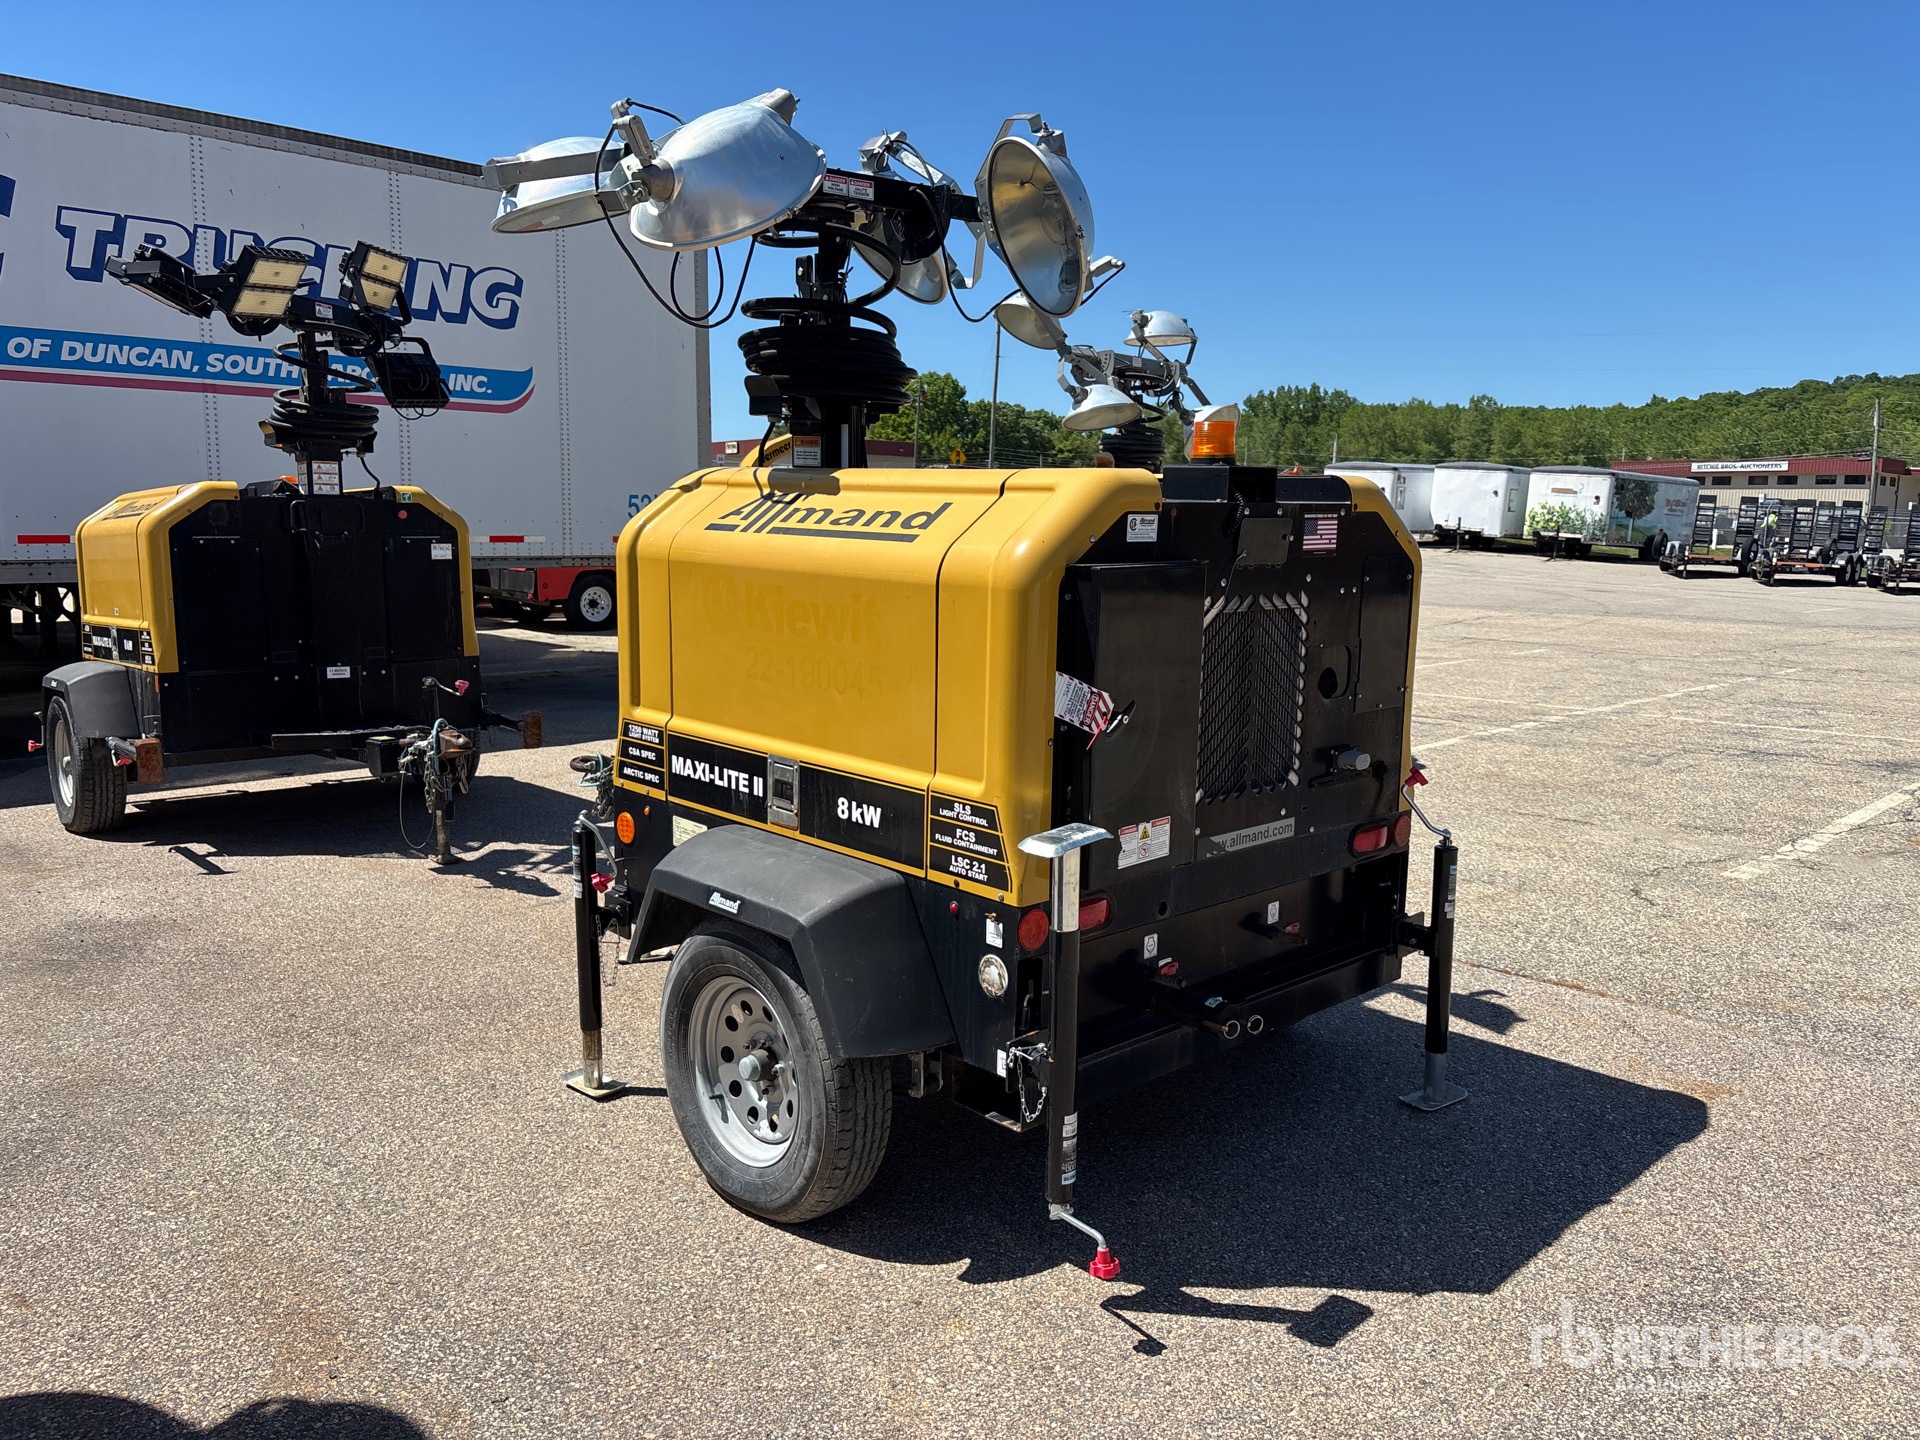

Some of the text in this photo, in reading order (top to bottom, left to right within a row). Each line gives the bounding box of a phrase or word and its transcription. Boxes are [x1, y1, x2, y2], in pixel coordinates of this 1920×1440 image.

[7, 336, 51, 359] OF
[60, 340, 200, 373] DUNCAN,
[206, 353, 299, 379] SOUTH
[448, 373, 493, 395] INC.
[762, 440, 792, 464] ermeer
[718, 492, 954, 534] Allmand
[628, 724, 659, 738] 1250 WATT
[642, 735, 660, 743] SYSTEM
[628, 746, 656, 760] CSA SPEC
[623, 766, 660, 784] ARCTIC SPEC
[671, 754, 764, 797] MAXI-LITE II
[837, 796, 882, 829] 8 kW
[939, 807, 989, 827] LIGHT CONTROL
[953, 802, 972, 815] SLS
[935, 833, 998, 856] FLUID CONTAINMENT
[955, 828, 976, 843] FCS
[949, 865, 989, 882] AUTO START
[951, 854, 986, 874] LSC 2.1
